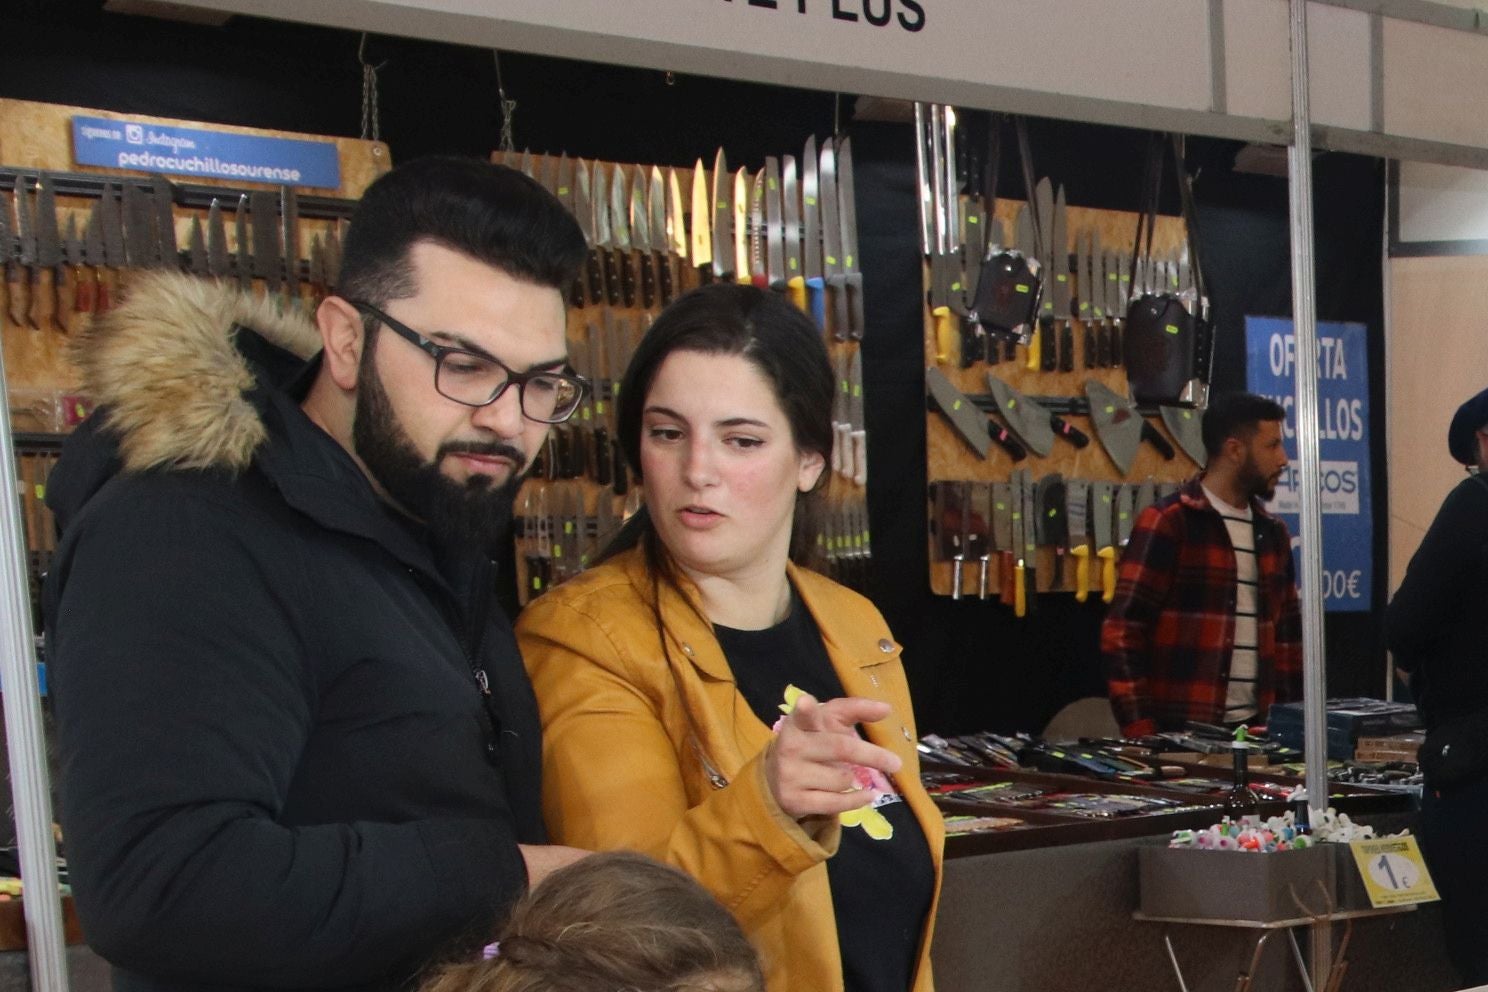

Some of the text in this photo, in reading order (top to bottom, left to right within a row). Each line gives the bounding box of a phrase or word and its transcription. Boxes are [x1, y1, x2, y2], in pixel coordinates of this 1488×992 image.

[118, 150, 301, 182] pedrocuchillosourense
[1269, 333, 1347, 380] OFTA
[1378, 855, 1399, 890] 1
